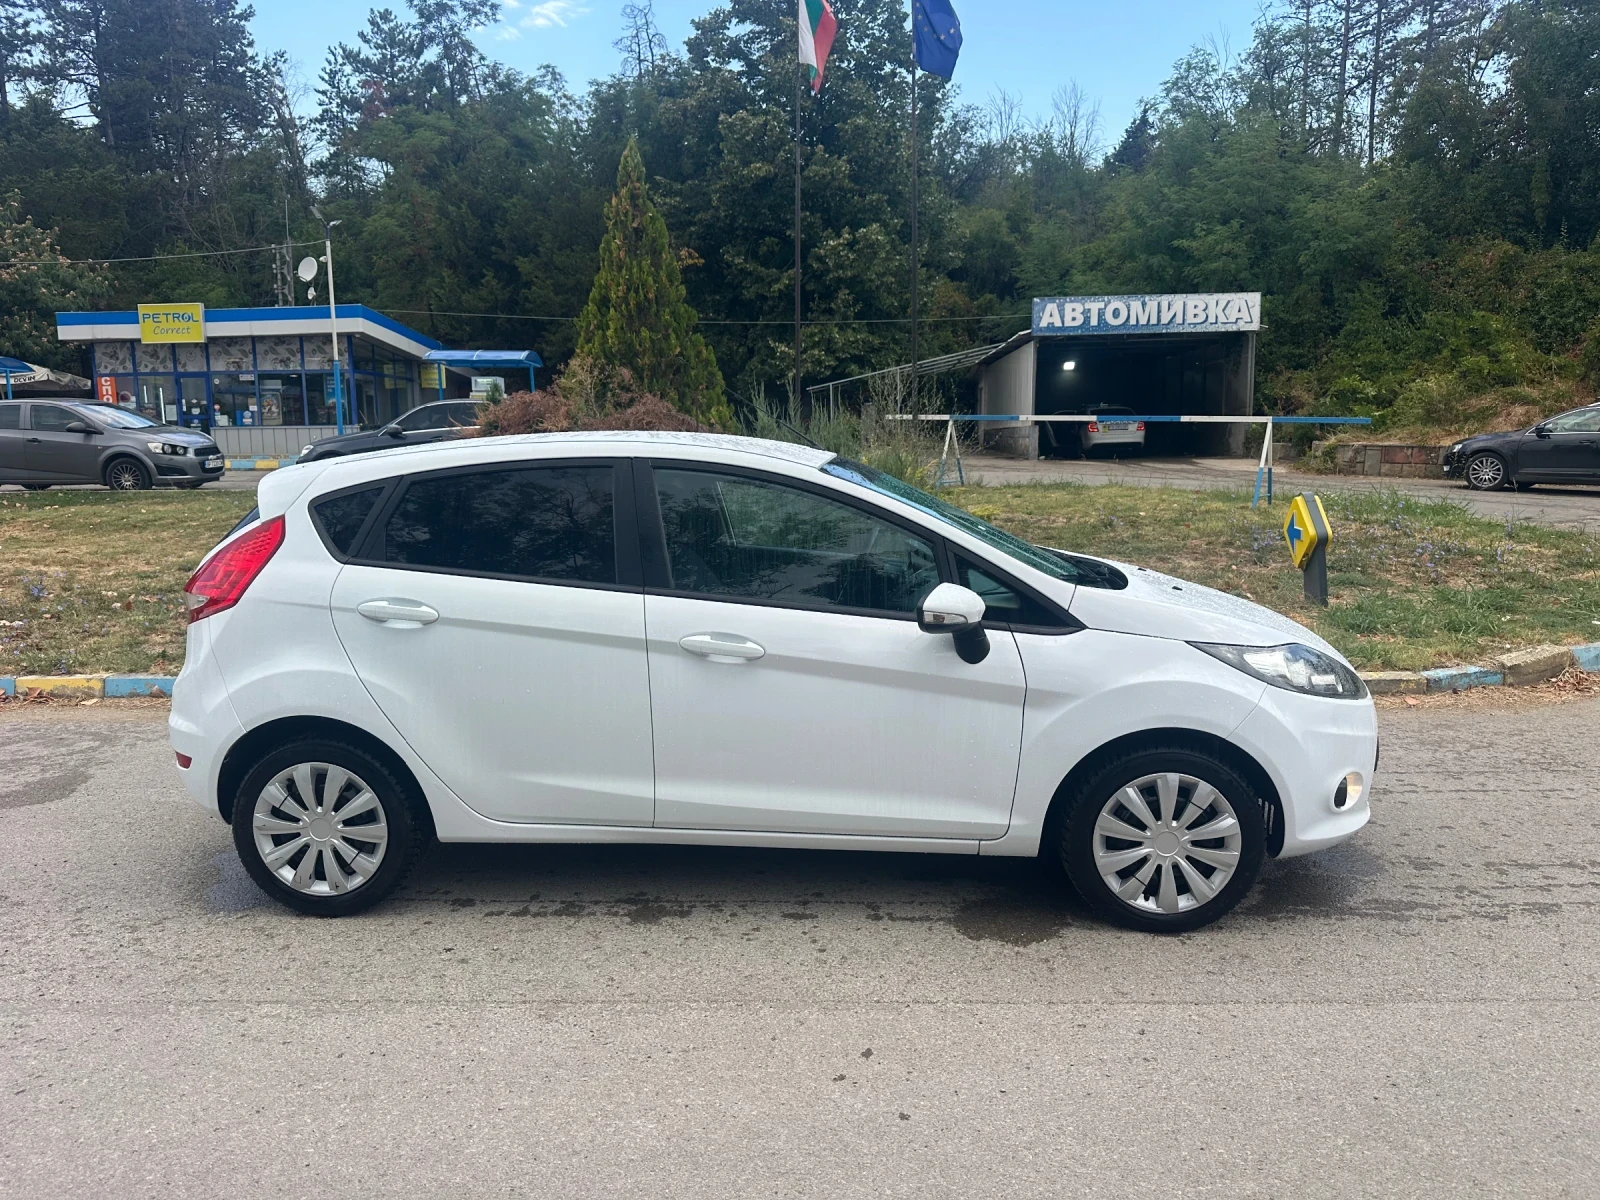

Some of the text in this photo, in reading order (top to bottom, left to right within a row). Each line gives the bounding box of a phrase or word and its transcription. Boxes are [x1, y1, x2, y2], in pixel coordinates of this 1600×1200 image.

[142, 312, 200, 323] PETROL
[1039, 298, 1253, 328] АВТОМИВКА
[153, 325, 191, 335] Correct
